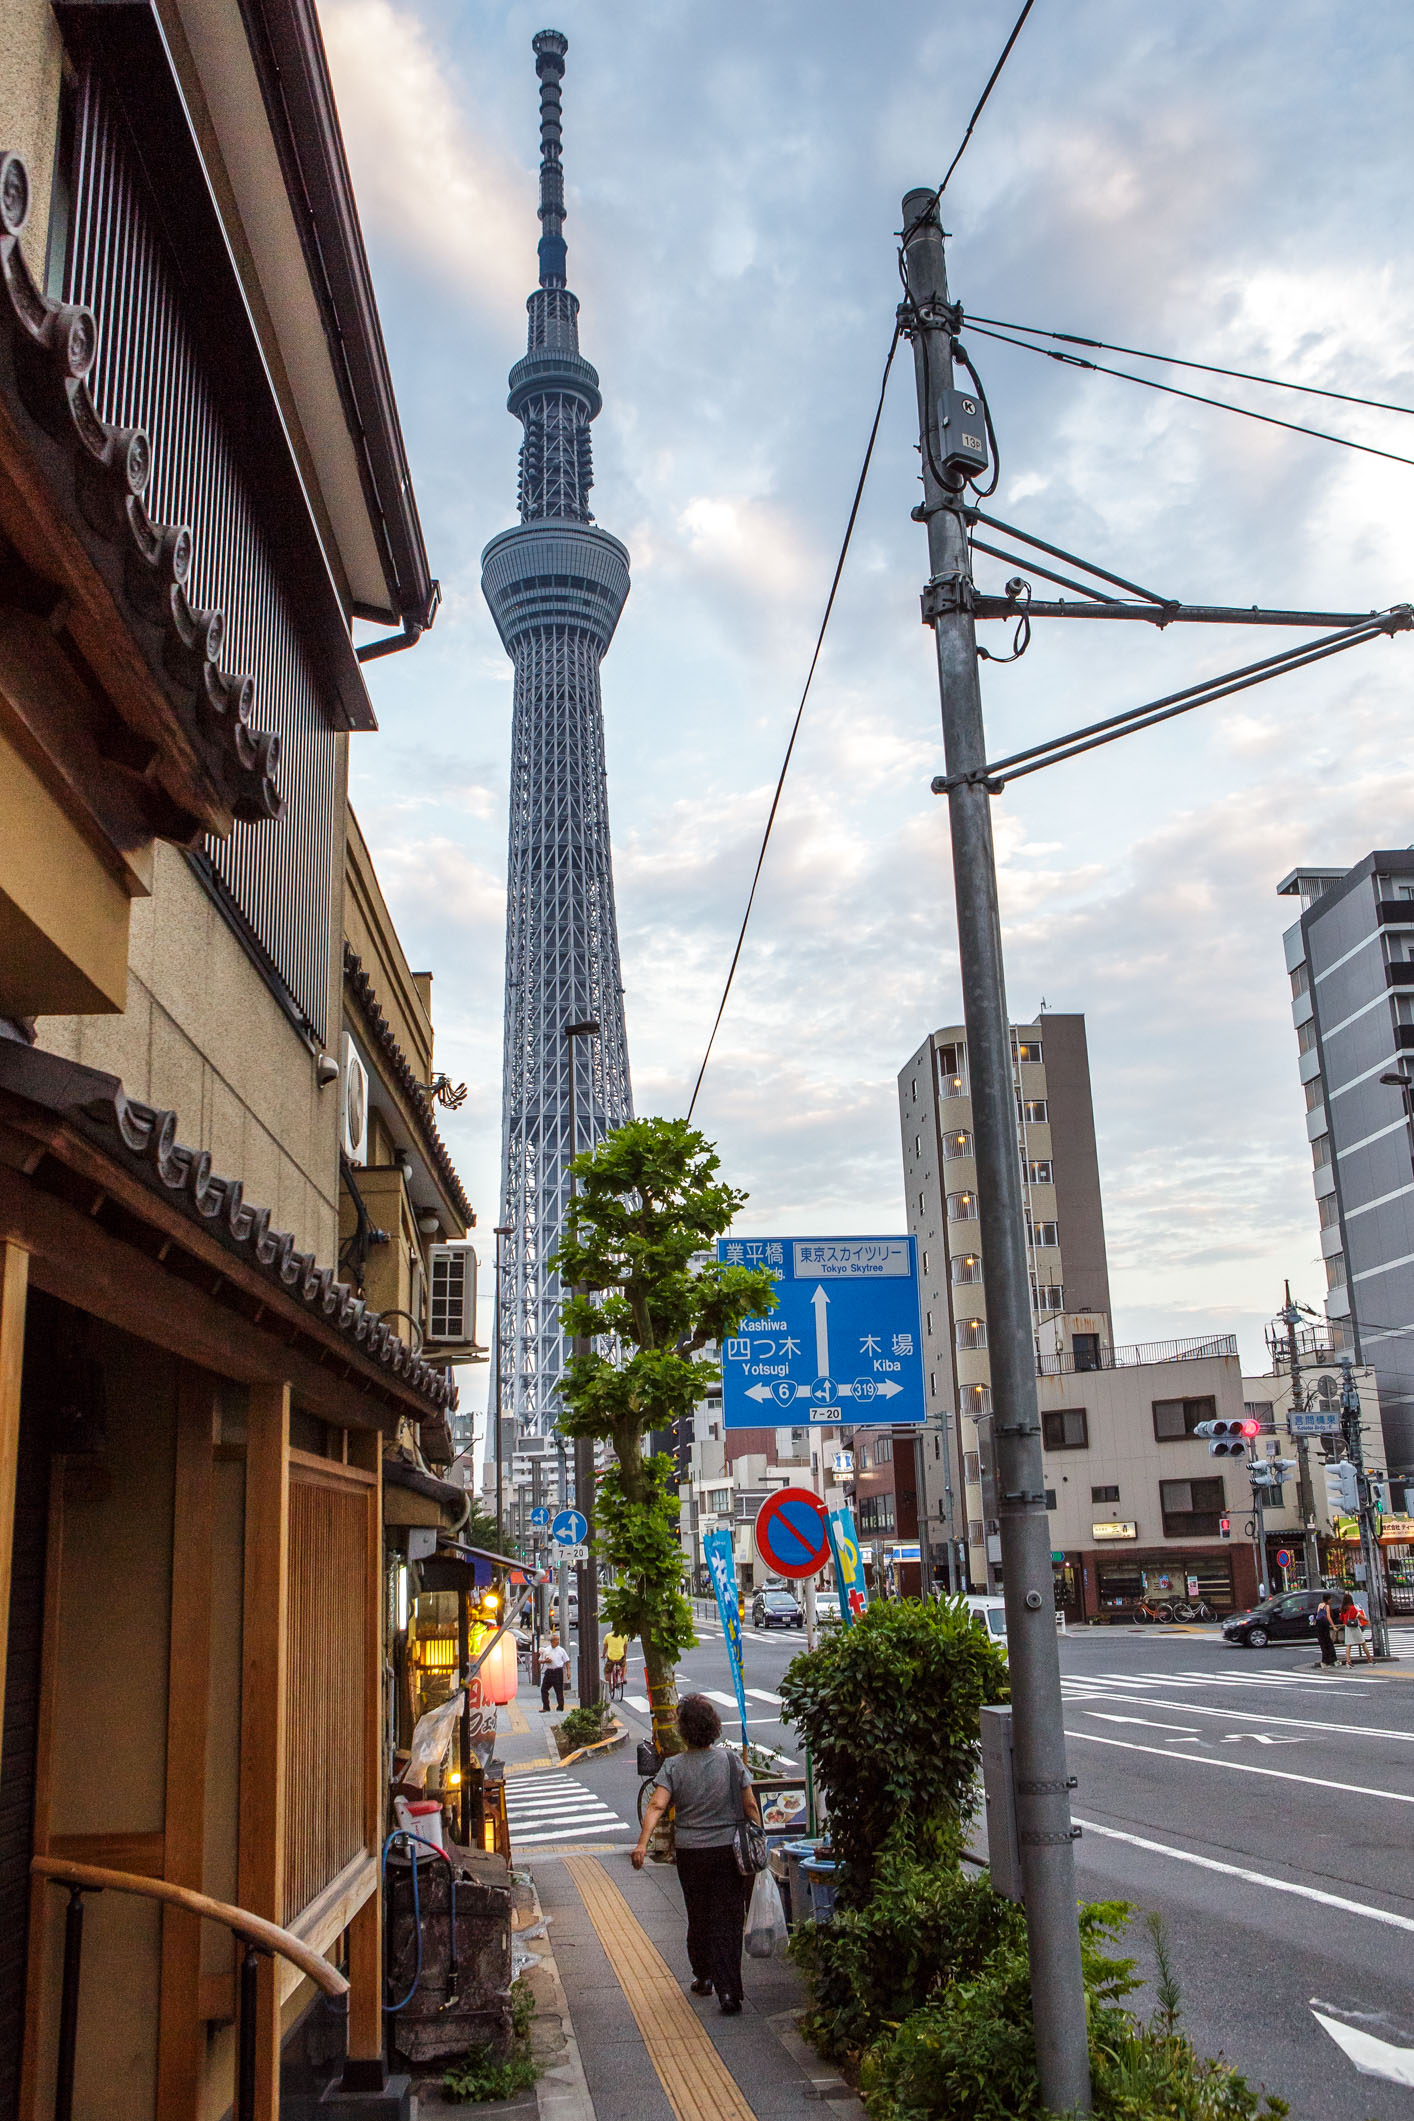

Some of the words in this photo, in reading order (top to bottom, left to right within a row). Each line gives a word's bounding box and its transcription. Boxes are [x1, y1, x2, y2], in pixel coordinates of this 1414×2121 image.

[964, 402, 974, 413] K
[726, 1243, 784, 1265] 業平橋
[800, 1246, 902, 1263] 東京スカイツリー
[821, 1264, 847, 1274] Tokyo
[850, 1263, 883, 1274] Skytree
[740, 1319, 787, 1331] Kashiwa
[728, 1336, 801, 1359] 四つ木
[859, 1334, 914, 1357] 木場
[742, 1362, 789, 1377] Yotsugi
[873, 1360, 901, 1371] Kiba
[778, 1384, 789, 1398] 6
[855, 1384, 874, 1396] 319
[811, 1409, 840, 1419] 7-20
[559, 1549, 583, 1557] 7-20
